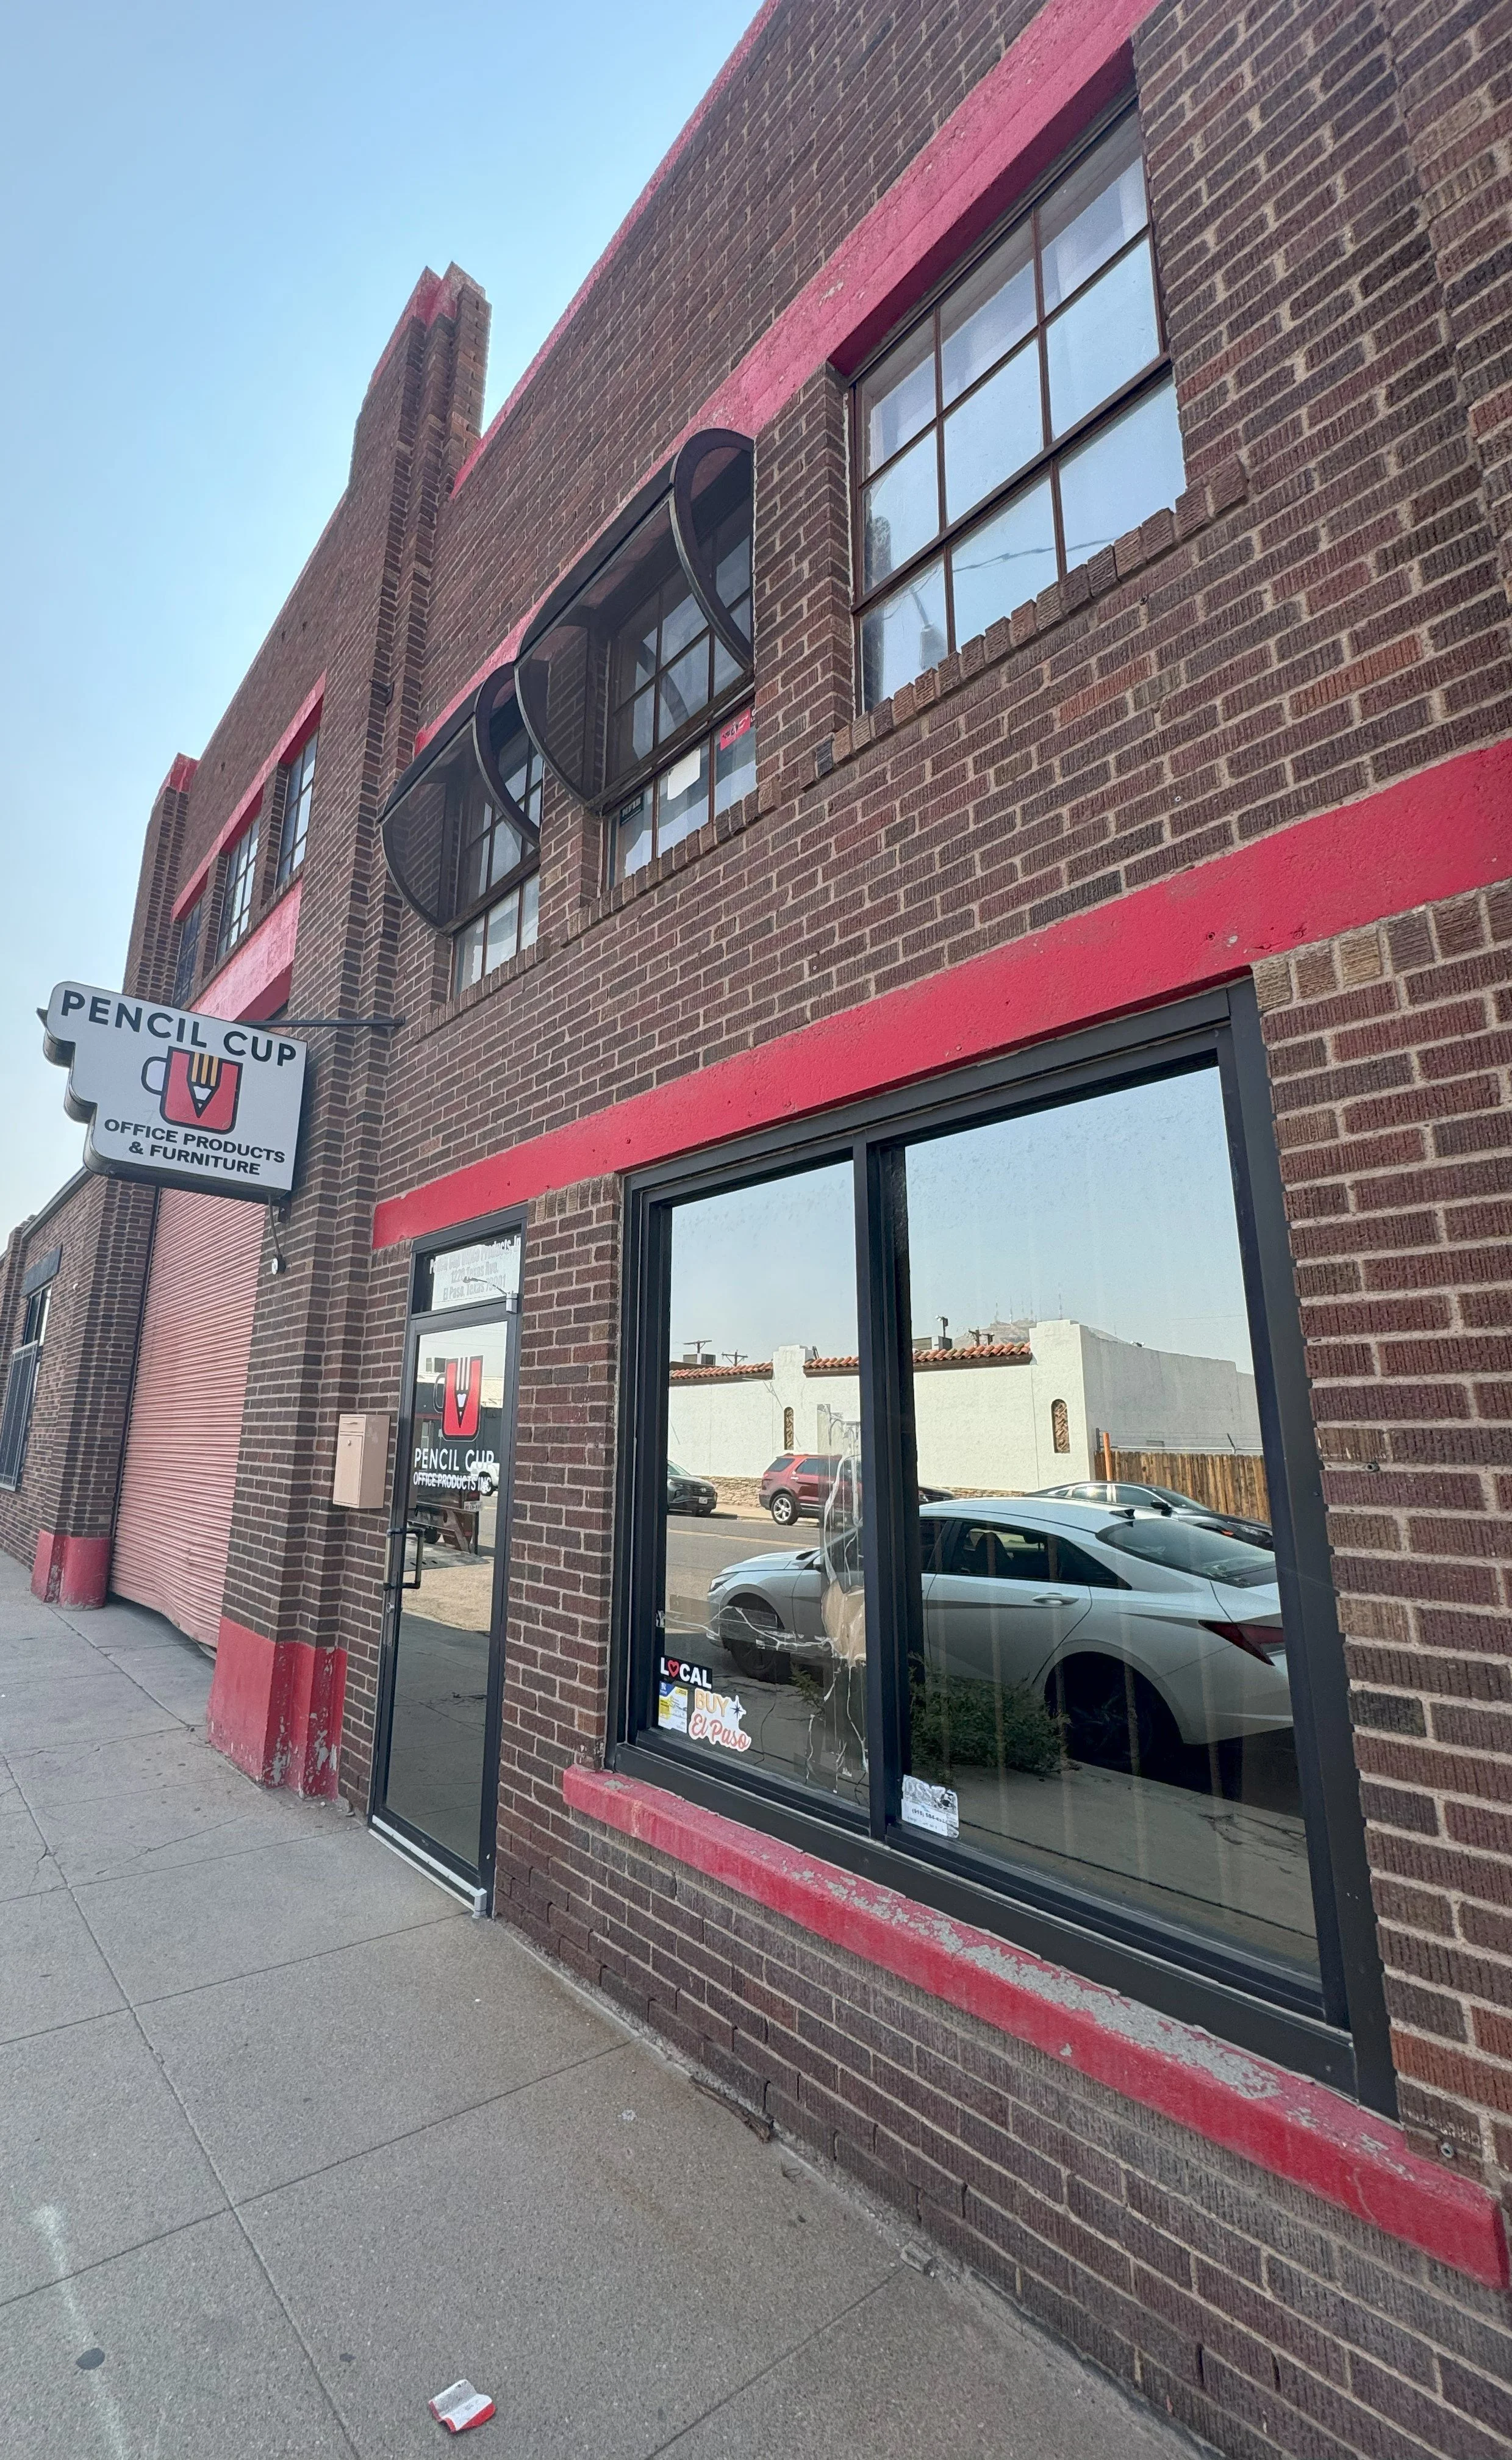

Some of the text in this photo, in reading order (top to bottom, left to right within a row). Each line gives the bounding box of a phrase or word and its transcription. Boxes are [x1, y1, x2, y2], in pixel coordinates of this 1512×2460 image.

[62, 990, 296, 1066] PENCIL CUP
[104, 1119, 285, 1163] OFFICE PRODUCTS
[129, 1142, 260, 1176] & FURNITURE
[443, 1287, 448, 1300] El
[466, 1282, 484, 1296] Texas
[414, 1448, 495, 1471] PENCIL CUP
[413, 1471, 492, 1493] OFFICE PRODUCTS INC
[696, 1691, 729, 1717] BUY
[691, 1713, 750, 1750] El Paso
